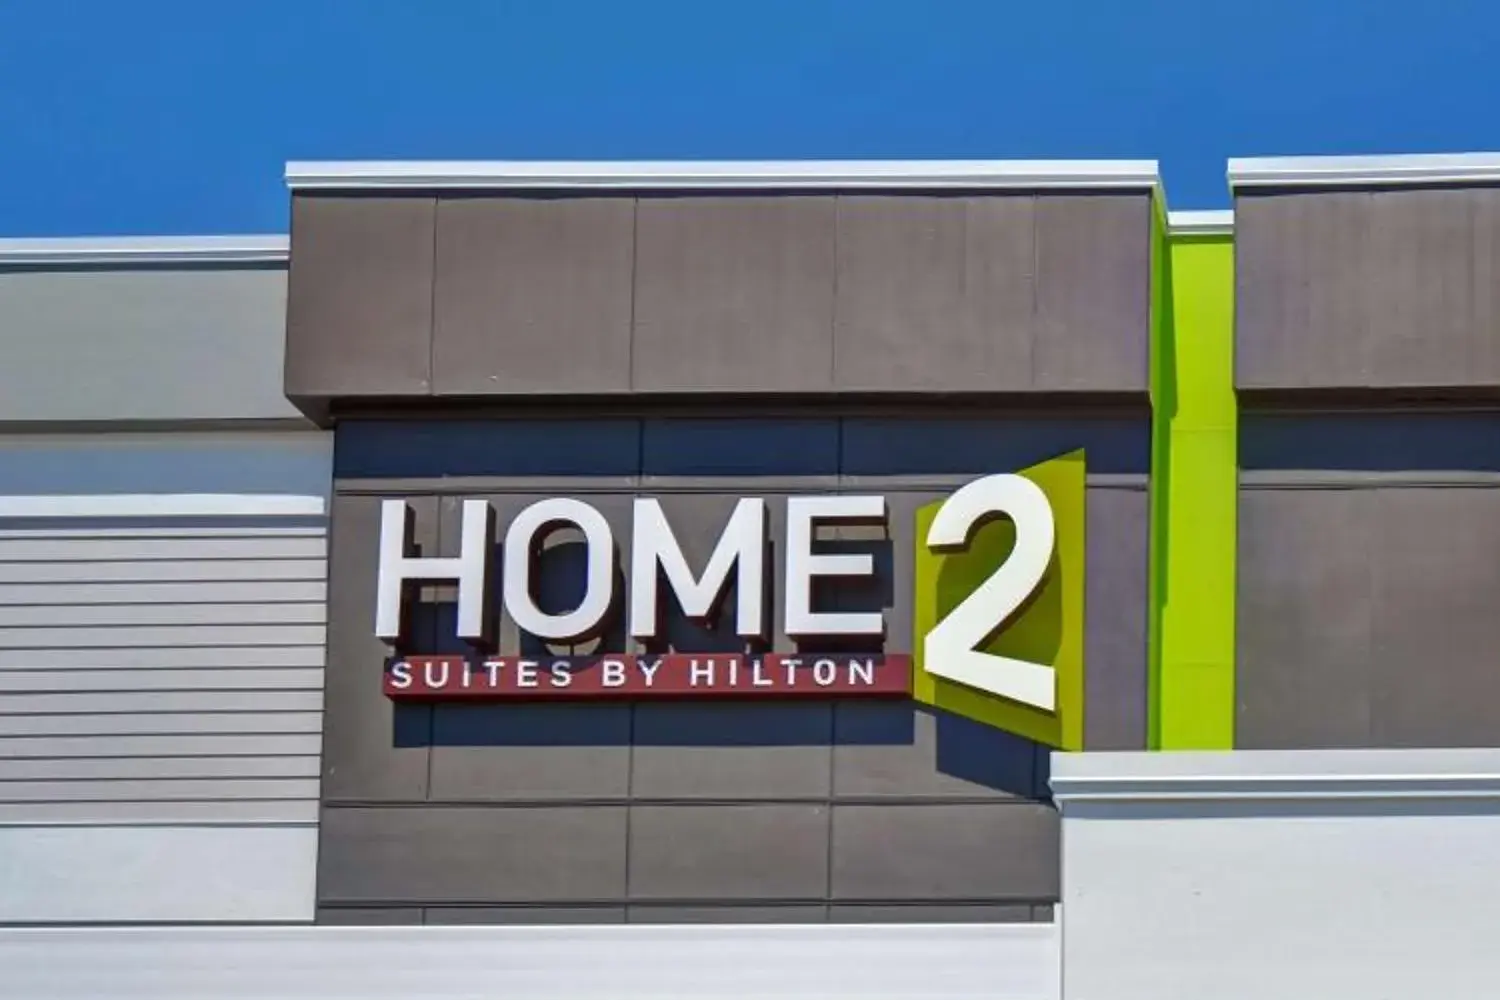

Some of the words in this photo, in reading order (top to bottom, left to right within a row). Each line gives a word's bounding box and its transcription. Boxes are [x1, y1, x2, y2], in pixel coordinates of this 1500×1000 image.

[391, 660, 573, 688] SUITES
[602, 659, 663, 688] BY
[690, 658, 874, 687] HILTON
